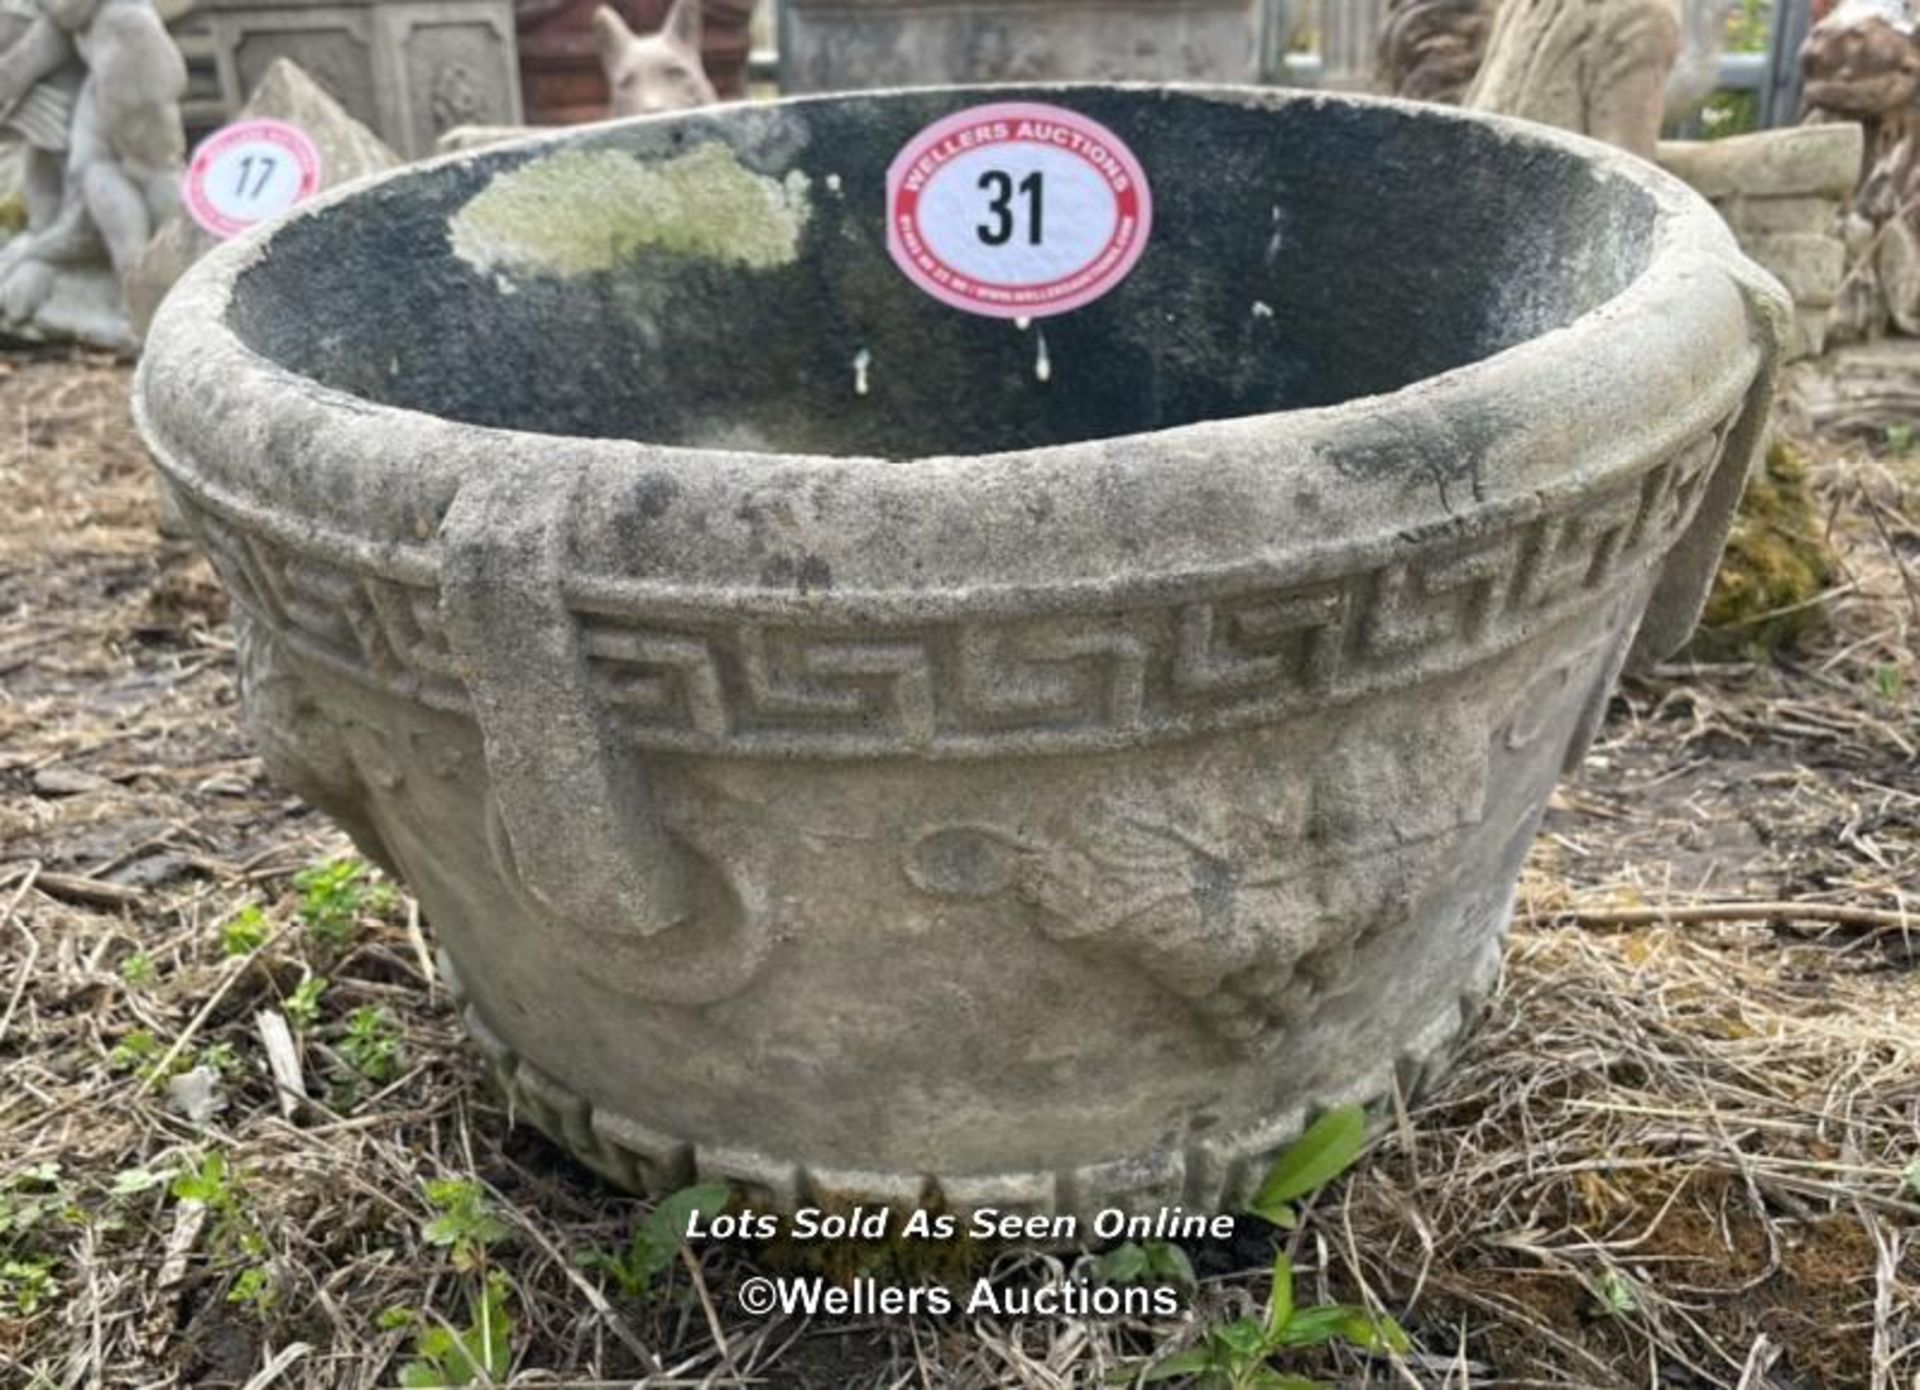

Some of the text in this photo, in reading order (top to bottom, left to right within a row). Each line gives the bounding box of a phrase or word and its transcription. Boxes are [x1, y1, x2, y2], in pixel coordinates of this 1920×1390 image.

[235, 155, 277, 199] 17
[904, 122, 1129, 192] WELLERS AUCTIONS
[976, 169, 1044, 246] 31
